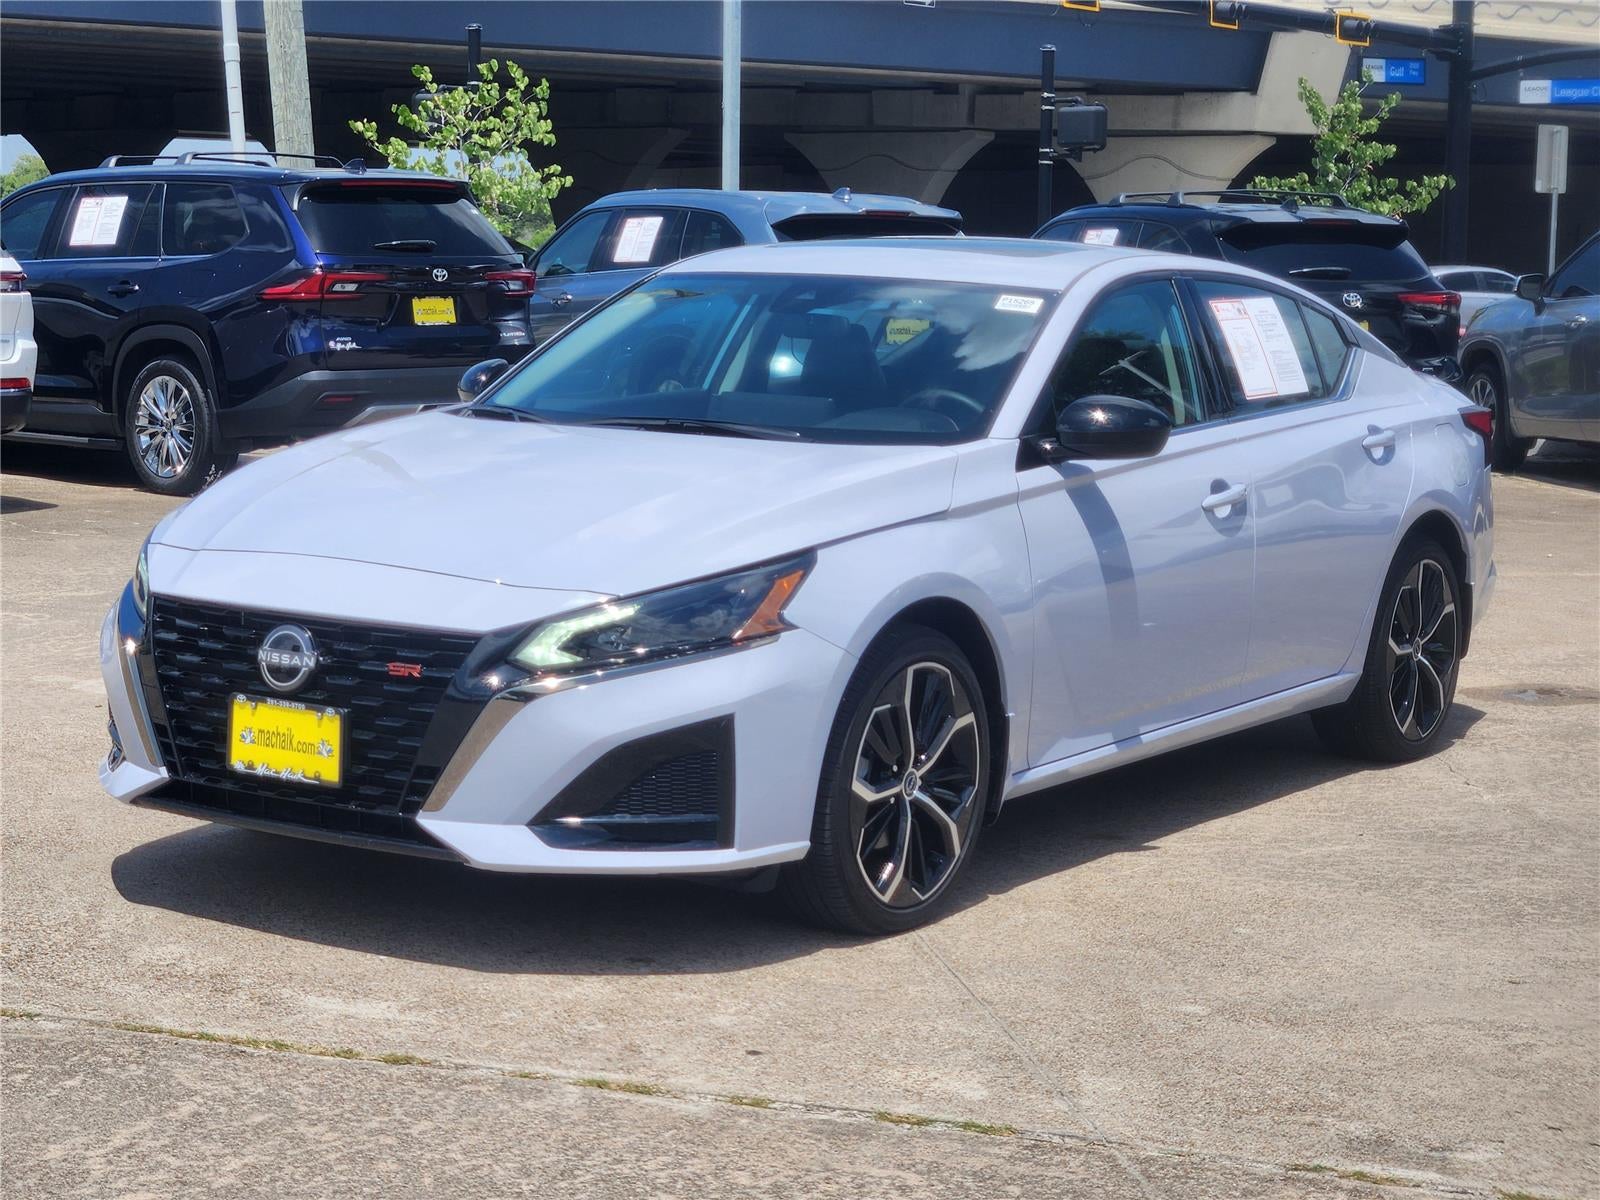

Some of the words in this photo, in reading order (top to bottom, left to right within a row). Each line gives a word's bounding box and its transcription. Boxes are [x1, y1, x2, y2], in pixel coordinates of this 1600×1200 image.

[1390, 66, 1405, 77] Gulf
[1554, 87, 1589, 100] League
[258, 650, 315, 667] NISSAN
[387, 661, 423, 677] SR
[256, 726, 316, 756] machaik.com
[255, 763, 276, 777] Mac
